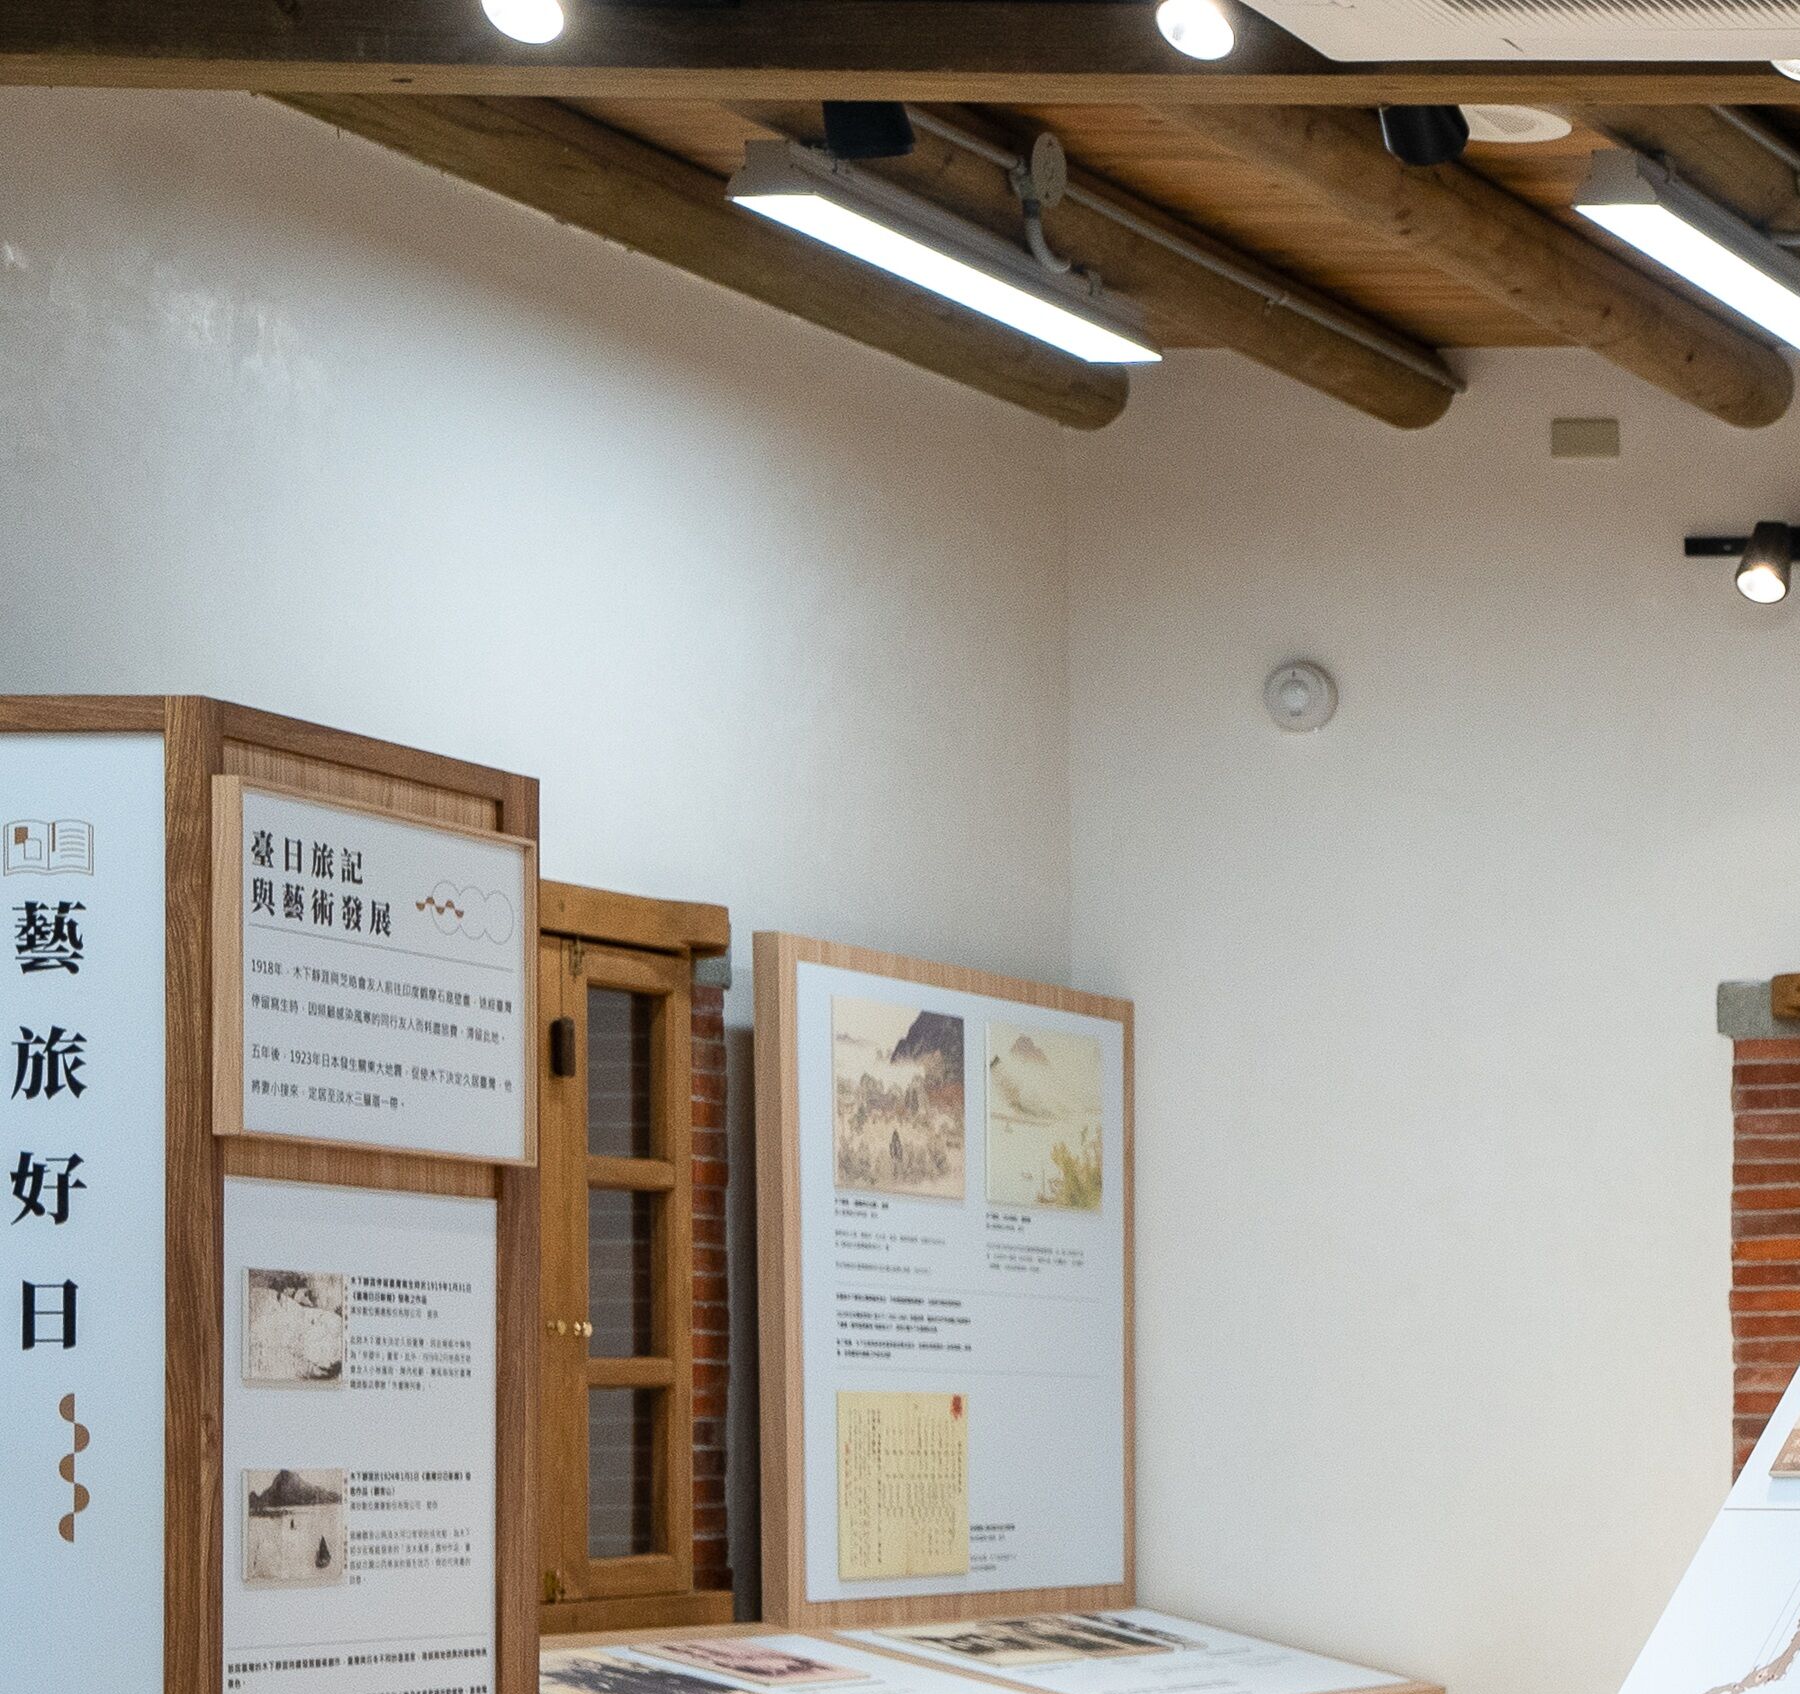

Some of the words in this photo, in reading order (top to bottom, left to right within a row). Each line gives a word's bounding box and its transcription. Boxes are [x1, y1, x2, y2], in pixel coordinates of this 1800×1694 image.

[251, 829, 365, 887] 臺日旅記
[250, 876, 393, 939] 與藝術發展
[9, 899, 89, 1350] 藝旅好日
